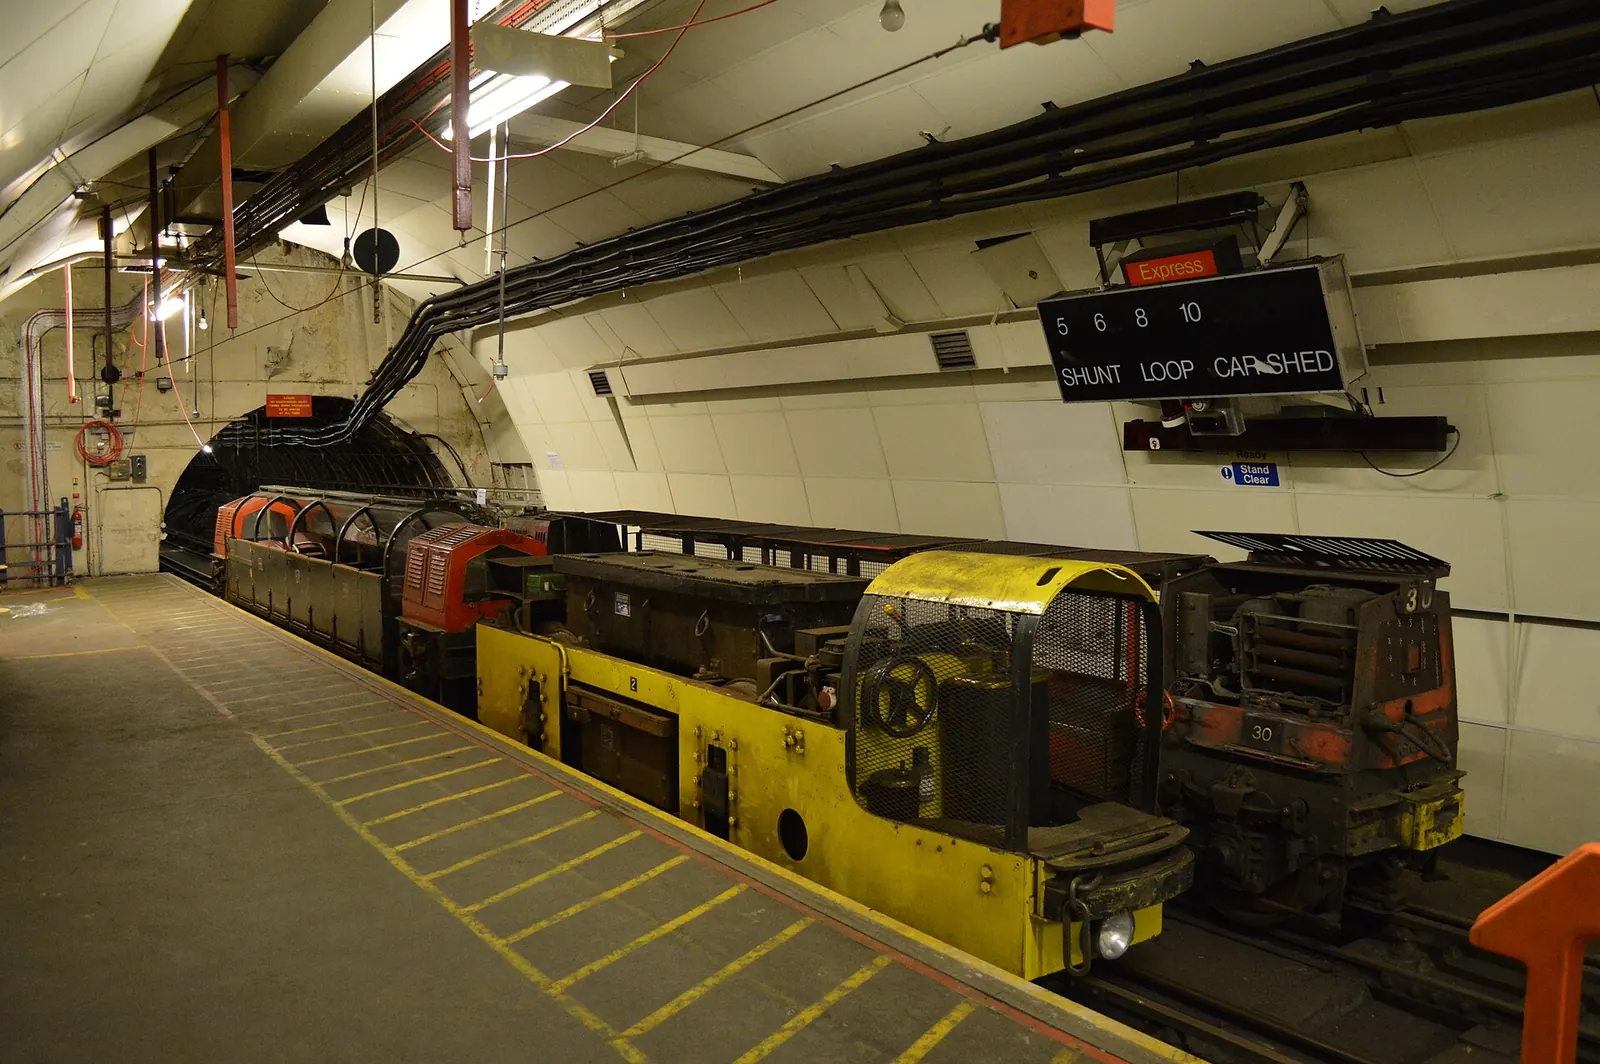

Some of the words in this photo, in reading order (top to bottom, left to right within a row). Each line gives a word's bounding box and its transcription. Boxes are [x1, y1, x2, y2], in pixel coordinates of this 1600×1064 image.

[1139, 259, 1204, 282] Express
[1057, 317, 1069, 336] 5
[1094, 312, 1107, 332] 6
[1135, 308, 1149, 328] 8
[1179, 302, 1202, 324] 10
[1061, 364, 1121, 387] SHUNT
[1140, 359, 1194, 382] LOOP
[1214, 355, 1260, 378] CAR
[1266, 350, 1334, 375] SHED
[1237, 450, 1267, 460] Ready
[1240, 464, 1270, 474] Stand
[1243, 475, 1269, 484] Clear
[1406, 588, 1432, 612] 30
[1252, 725, 1272, 742] 30
